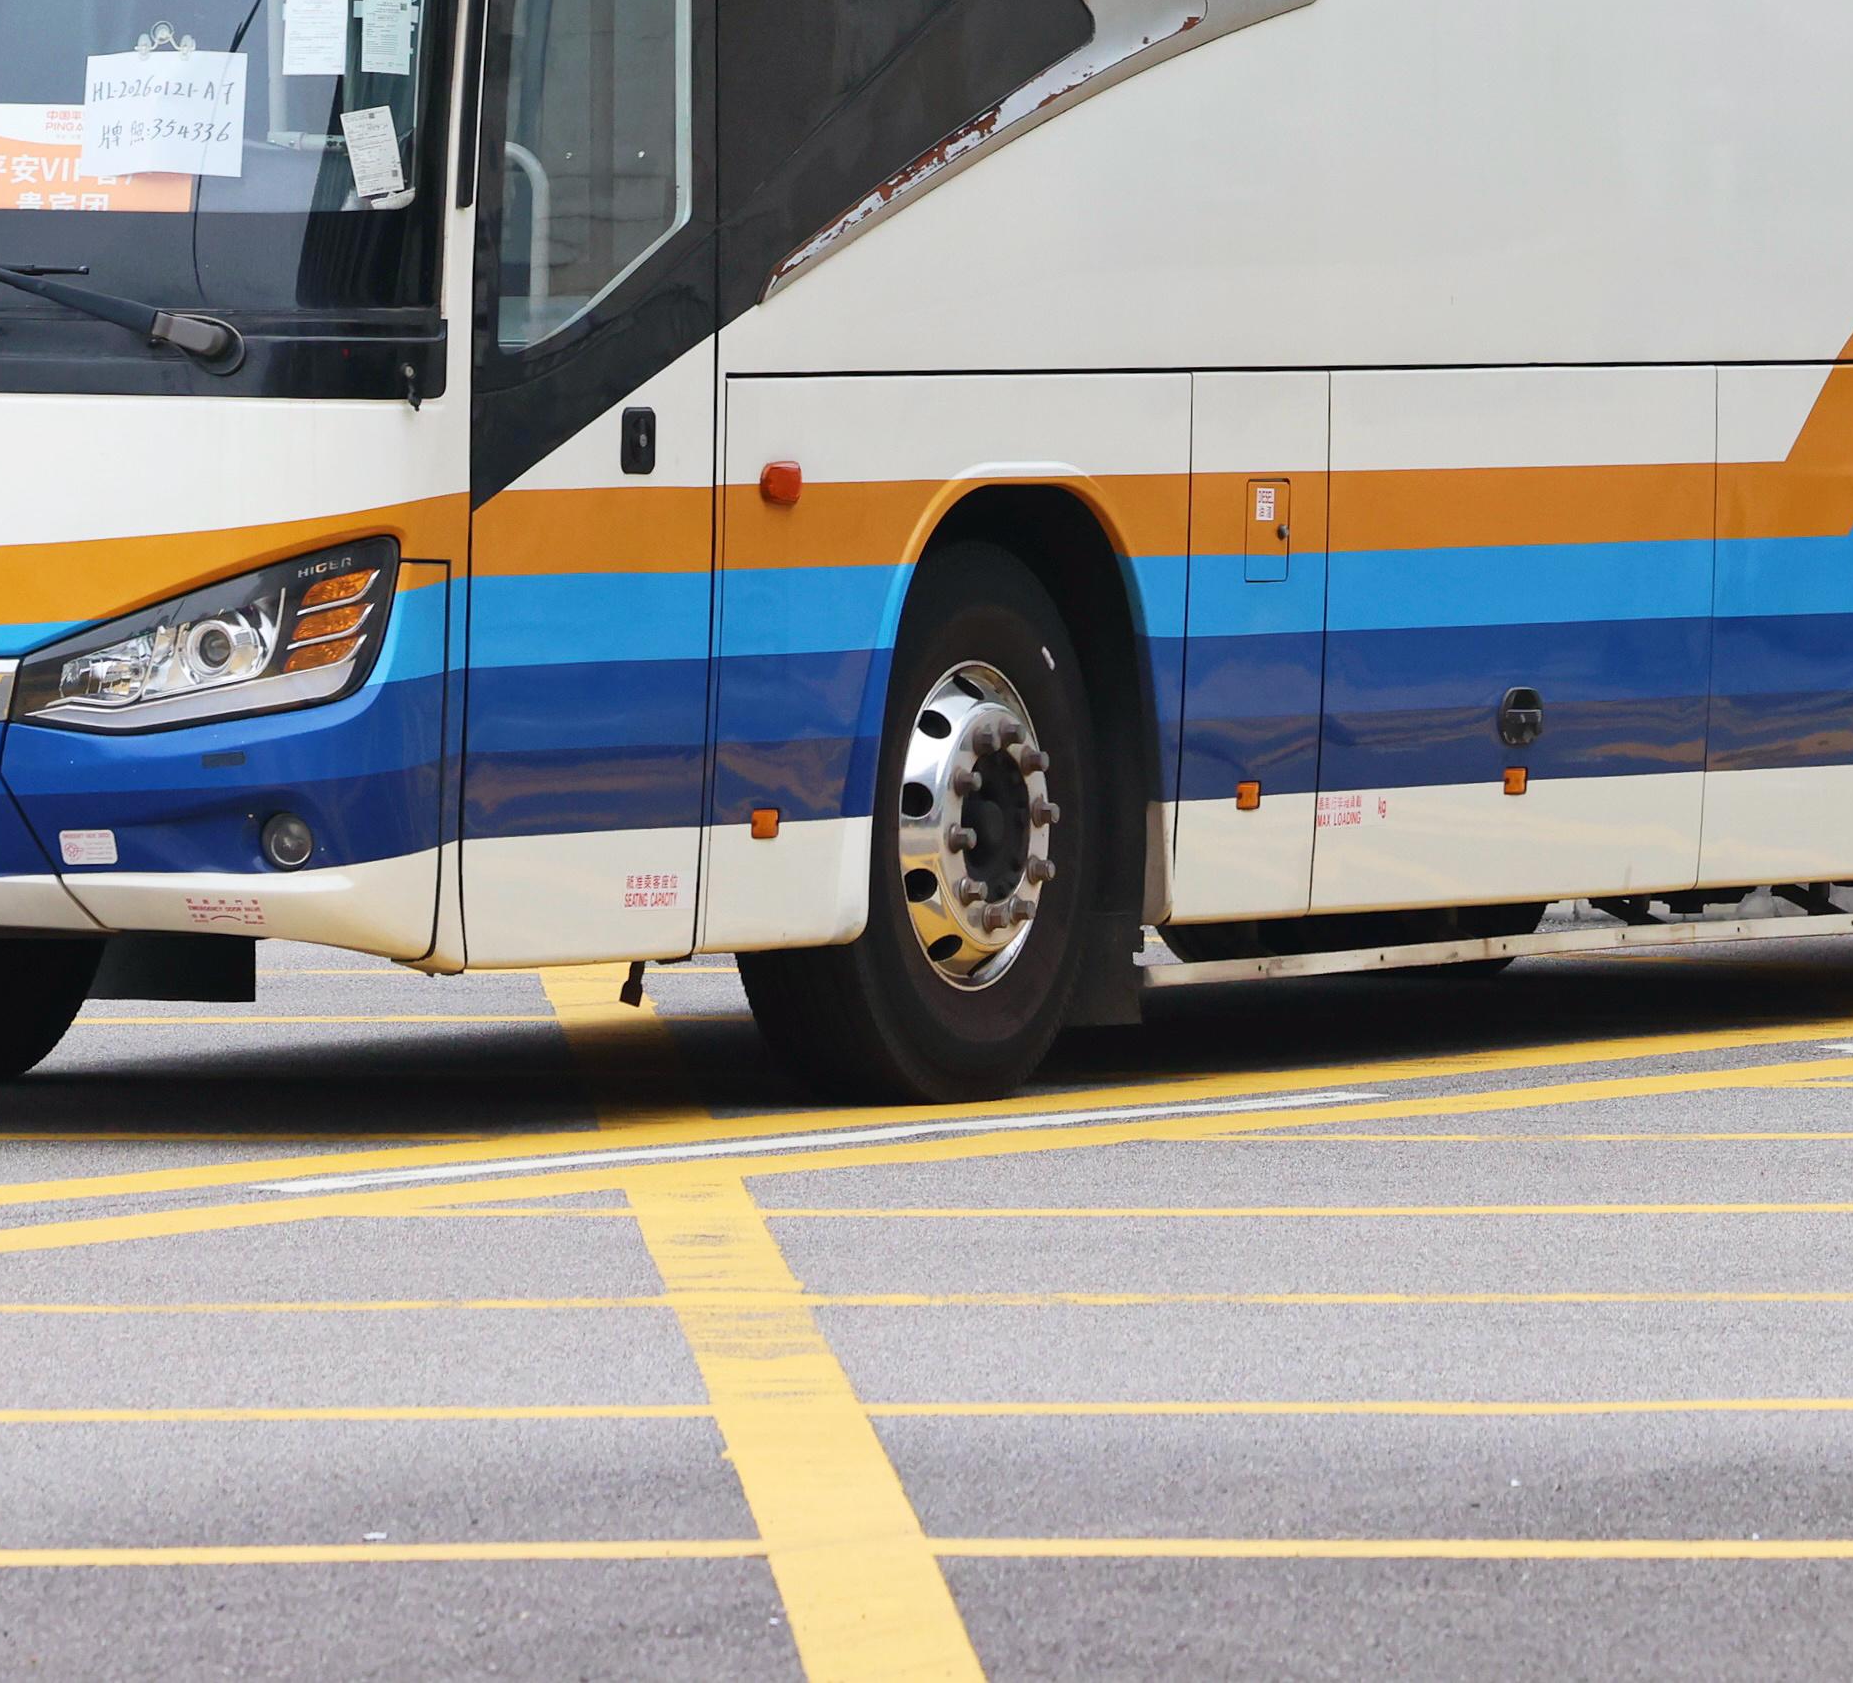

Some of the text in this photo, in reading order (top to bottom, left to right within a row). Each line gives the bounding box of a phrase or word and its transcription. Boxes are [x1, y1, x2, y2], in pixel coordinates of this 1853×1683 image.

[297, 557, 352, 579] HIGER
[1317, 796, 1387, 827] MAX LOADING kg
[625, 892, 677, 908] SEATING CAPACITY
